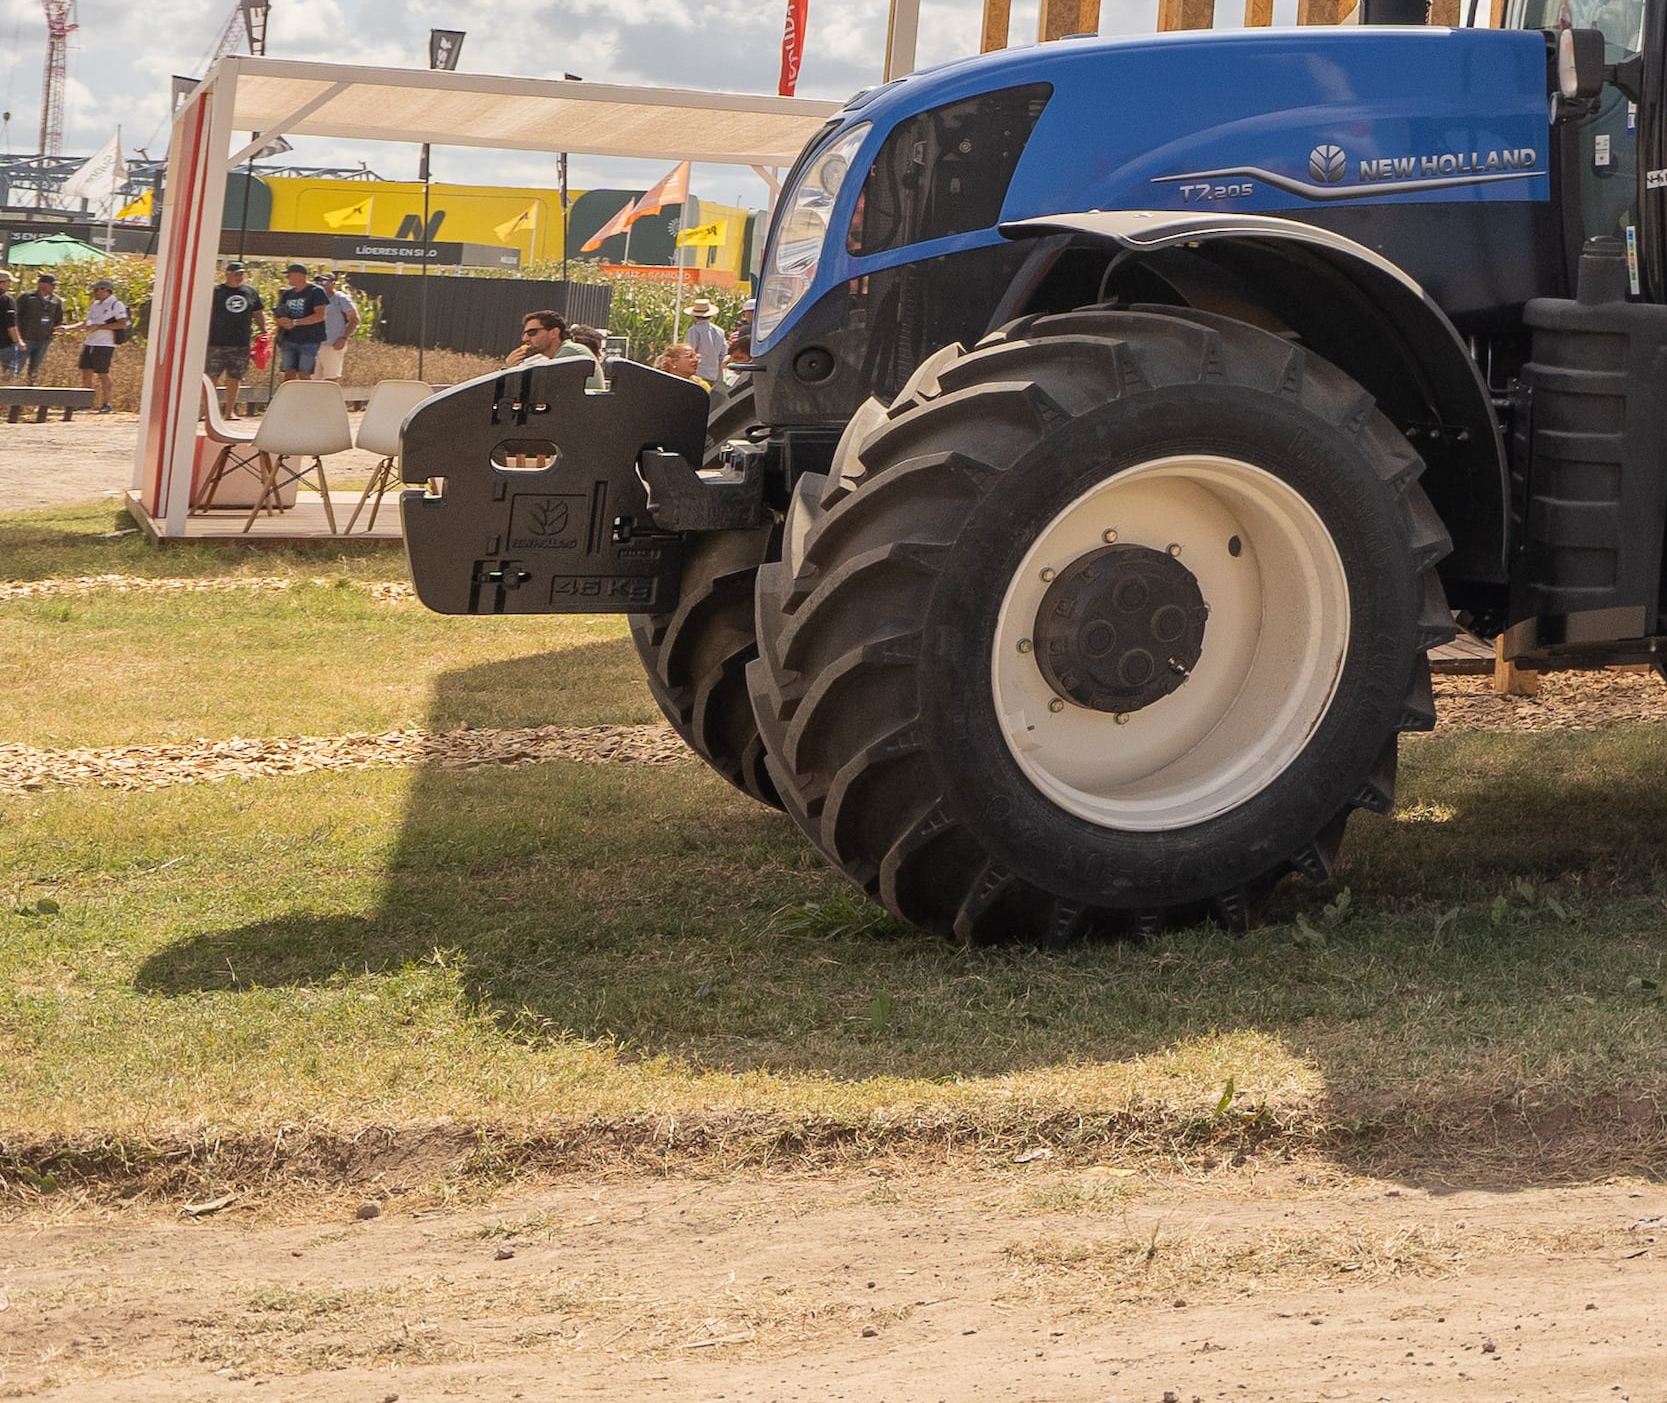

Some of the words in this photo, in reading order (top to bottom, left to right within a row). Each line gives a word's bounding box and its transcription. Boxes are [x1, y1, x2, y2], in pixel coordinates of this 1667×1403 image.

[1359, 156, 1416, 181] NEW
[1420, 148, 1537, 177] HOLLAND
[1179, 183, 1253, 203] T7.205
[399, 248, 413, 256] EN
